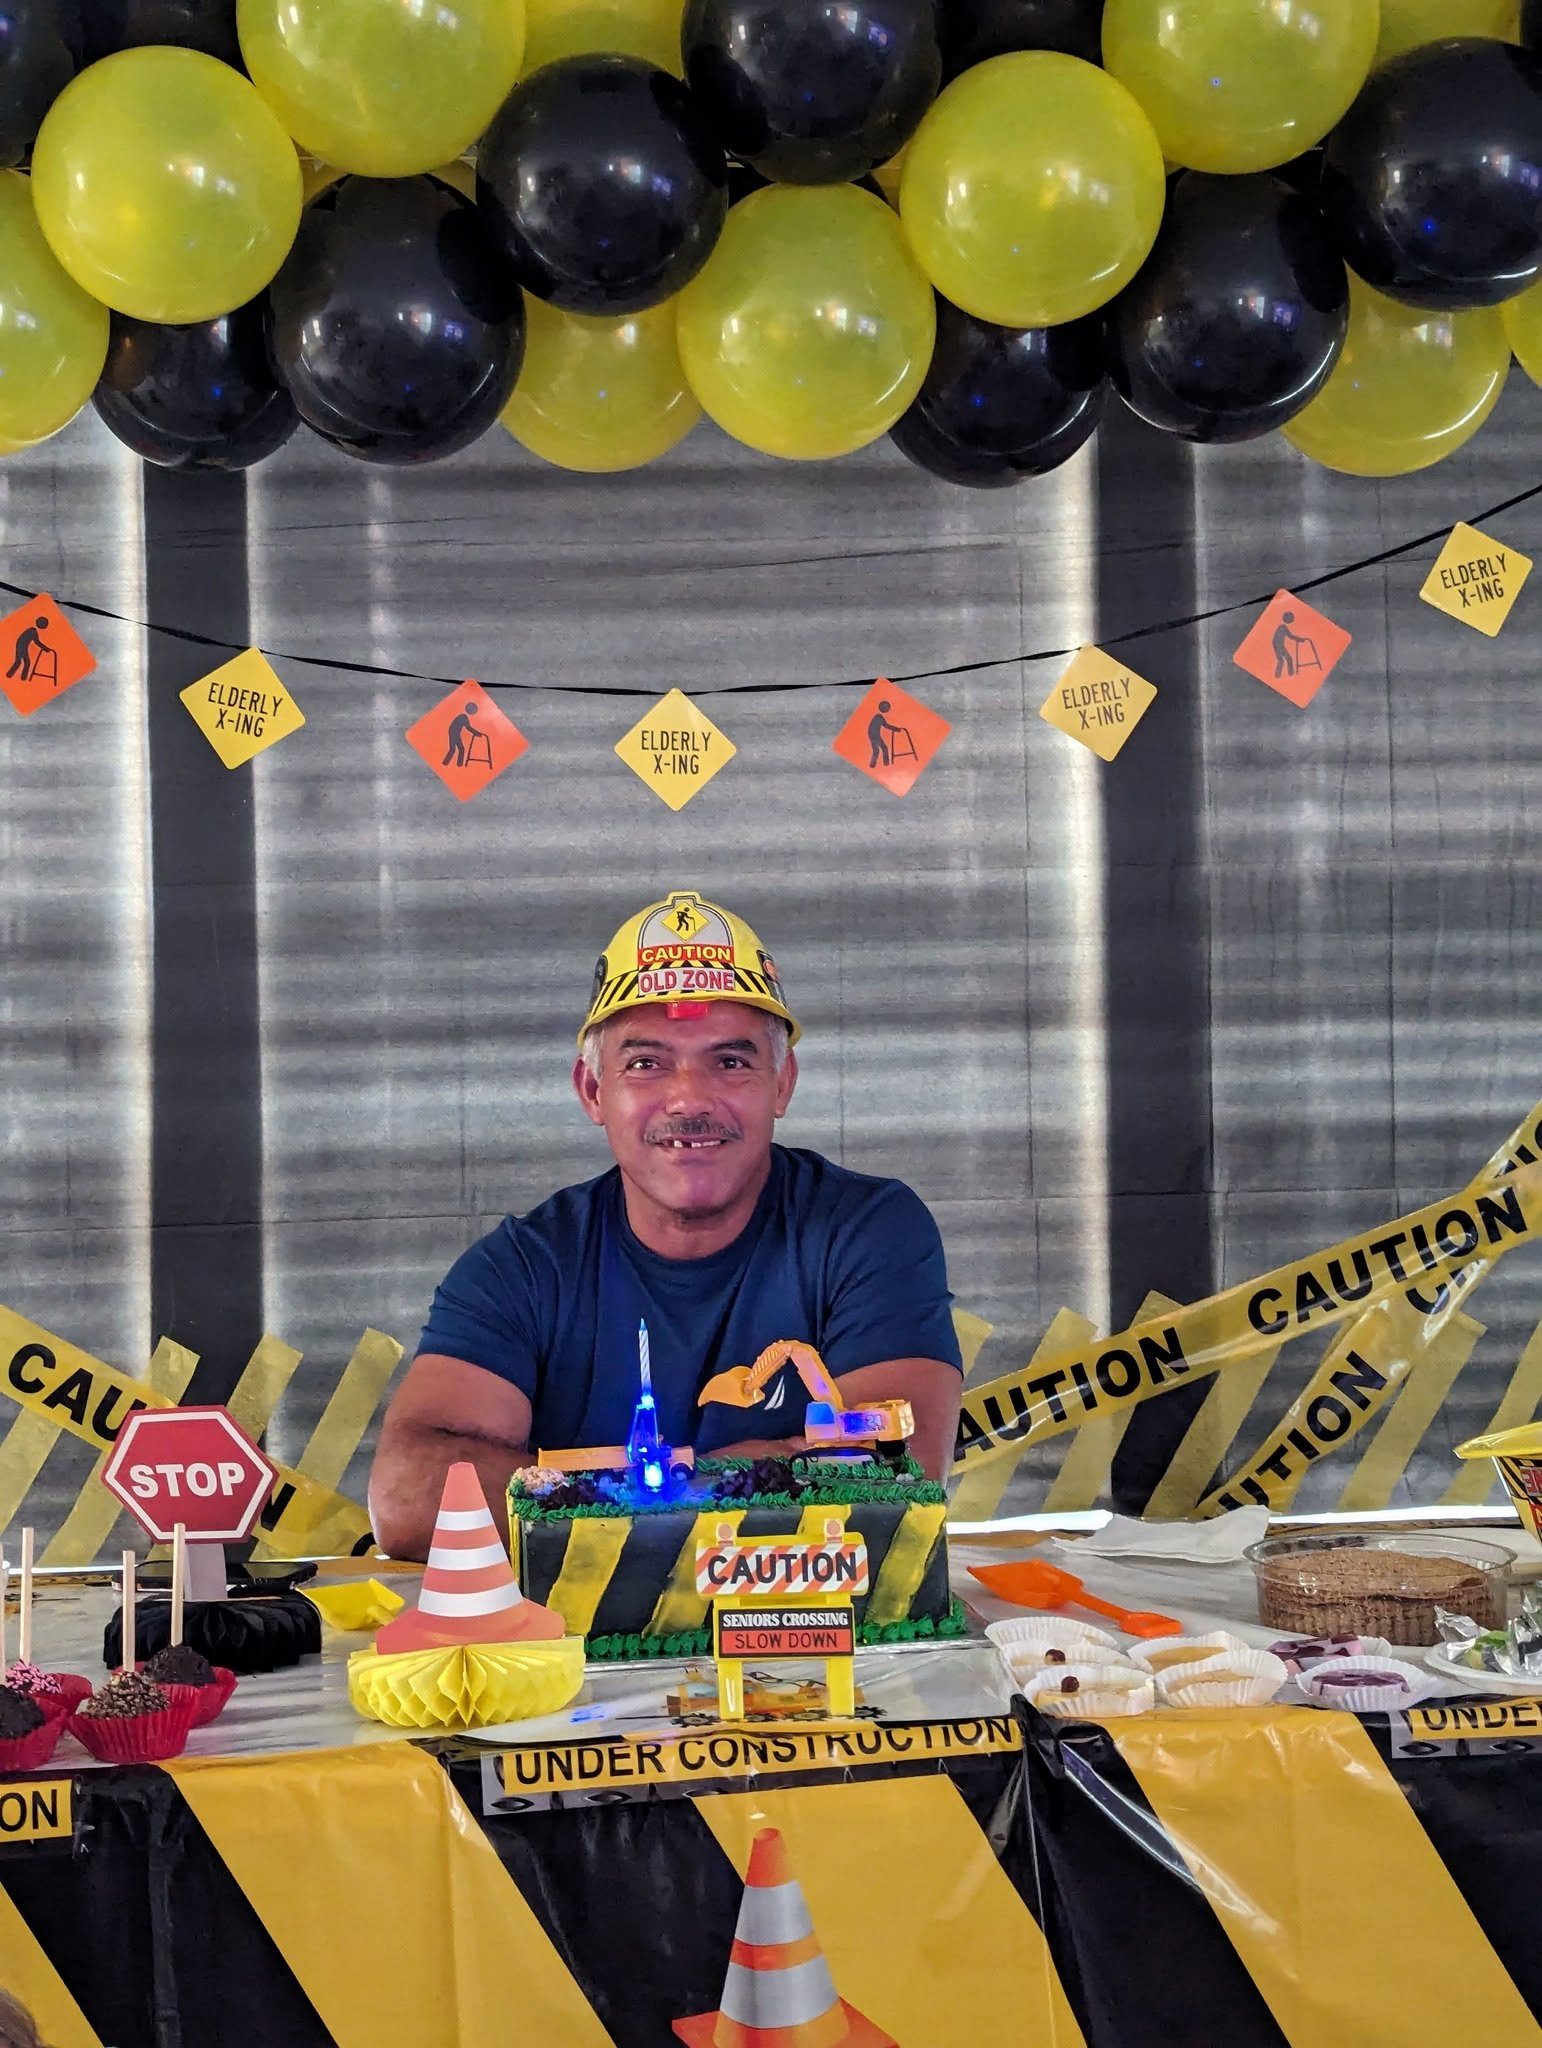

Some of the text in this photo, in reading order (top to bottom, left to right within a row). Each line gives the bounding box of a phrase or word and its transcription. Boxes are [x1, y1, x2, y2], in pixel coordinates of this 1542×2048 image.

[1440, 553, 1506, 589] ELDERLY
[1458, 578, 1504, 608] X-ING
[207, 682, 283, 717] ELDERLY
[1062, 678, 1130, 709] ELDERLY
[215, 708, 265, 738] X-ING
[1078, 702, 1125, 730] X-ING
[641, 730, 711, 752] ELDERLY
[654, 753, 700, 775] X-ING
[641, 946, 731, 962] CAUTION
[640, 969, 735, 993] OLD ZONE
[1247, 1186, 1528, 1335] CAUTION
[1204, 1350, 1388, 1519] UTION
[129, 1462, 246, 1498] STOP
[707, 1551, 858, 1585] CAUTION
[722, 1612, 849, 1627] SENIORS CROSSING
[735, 1632, 838, 1649] SLOW DOWN
[1421, 1701, 1542, 1731] UNDE
[515, 1743, 666, 1785] UNDER
